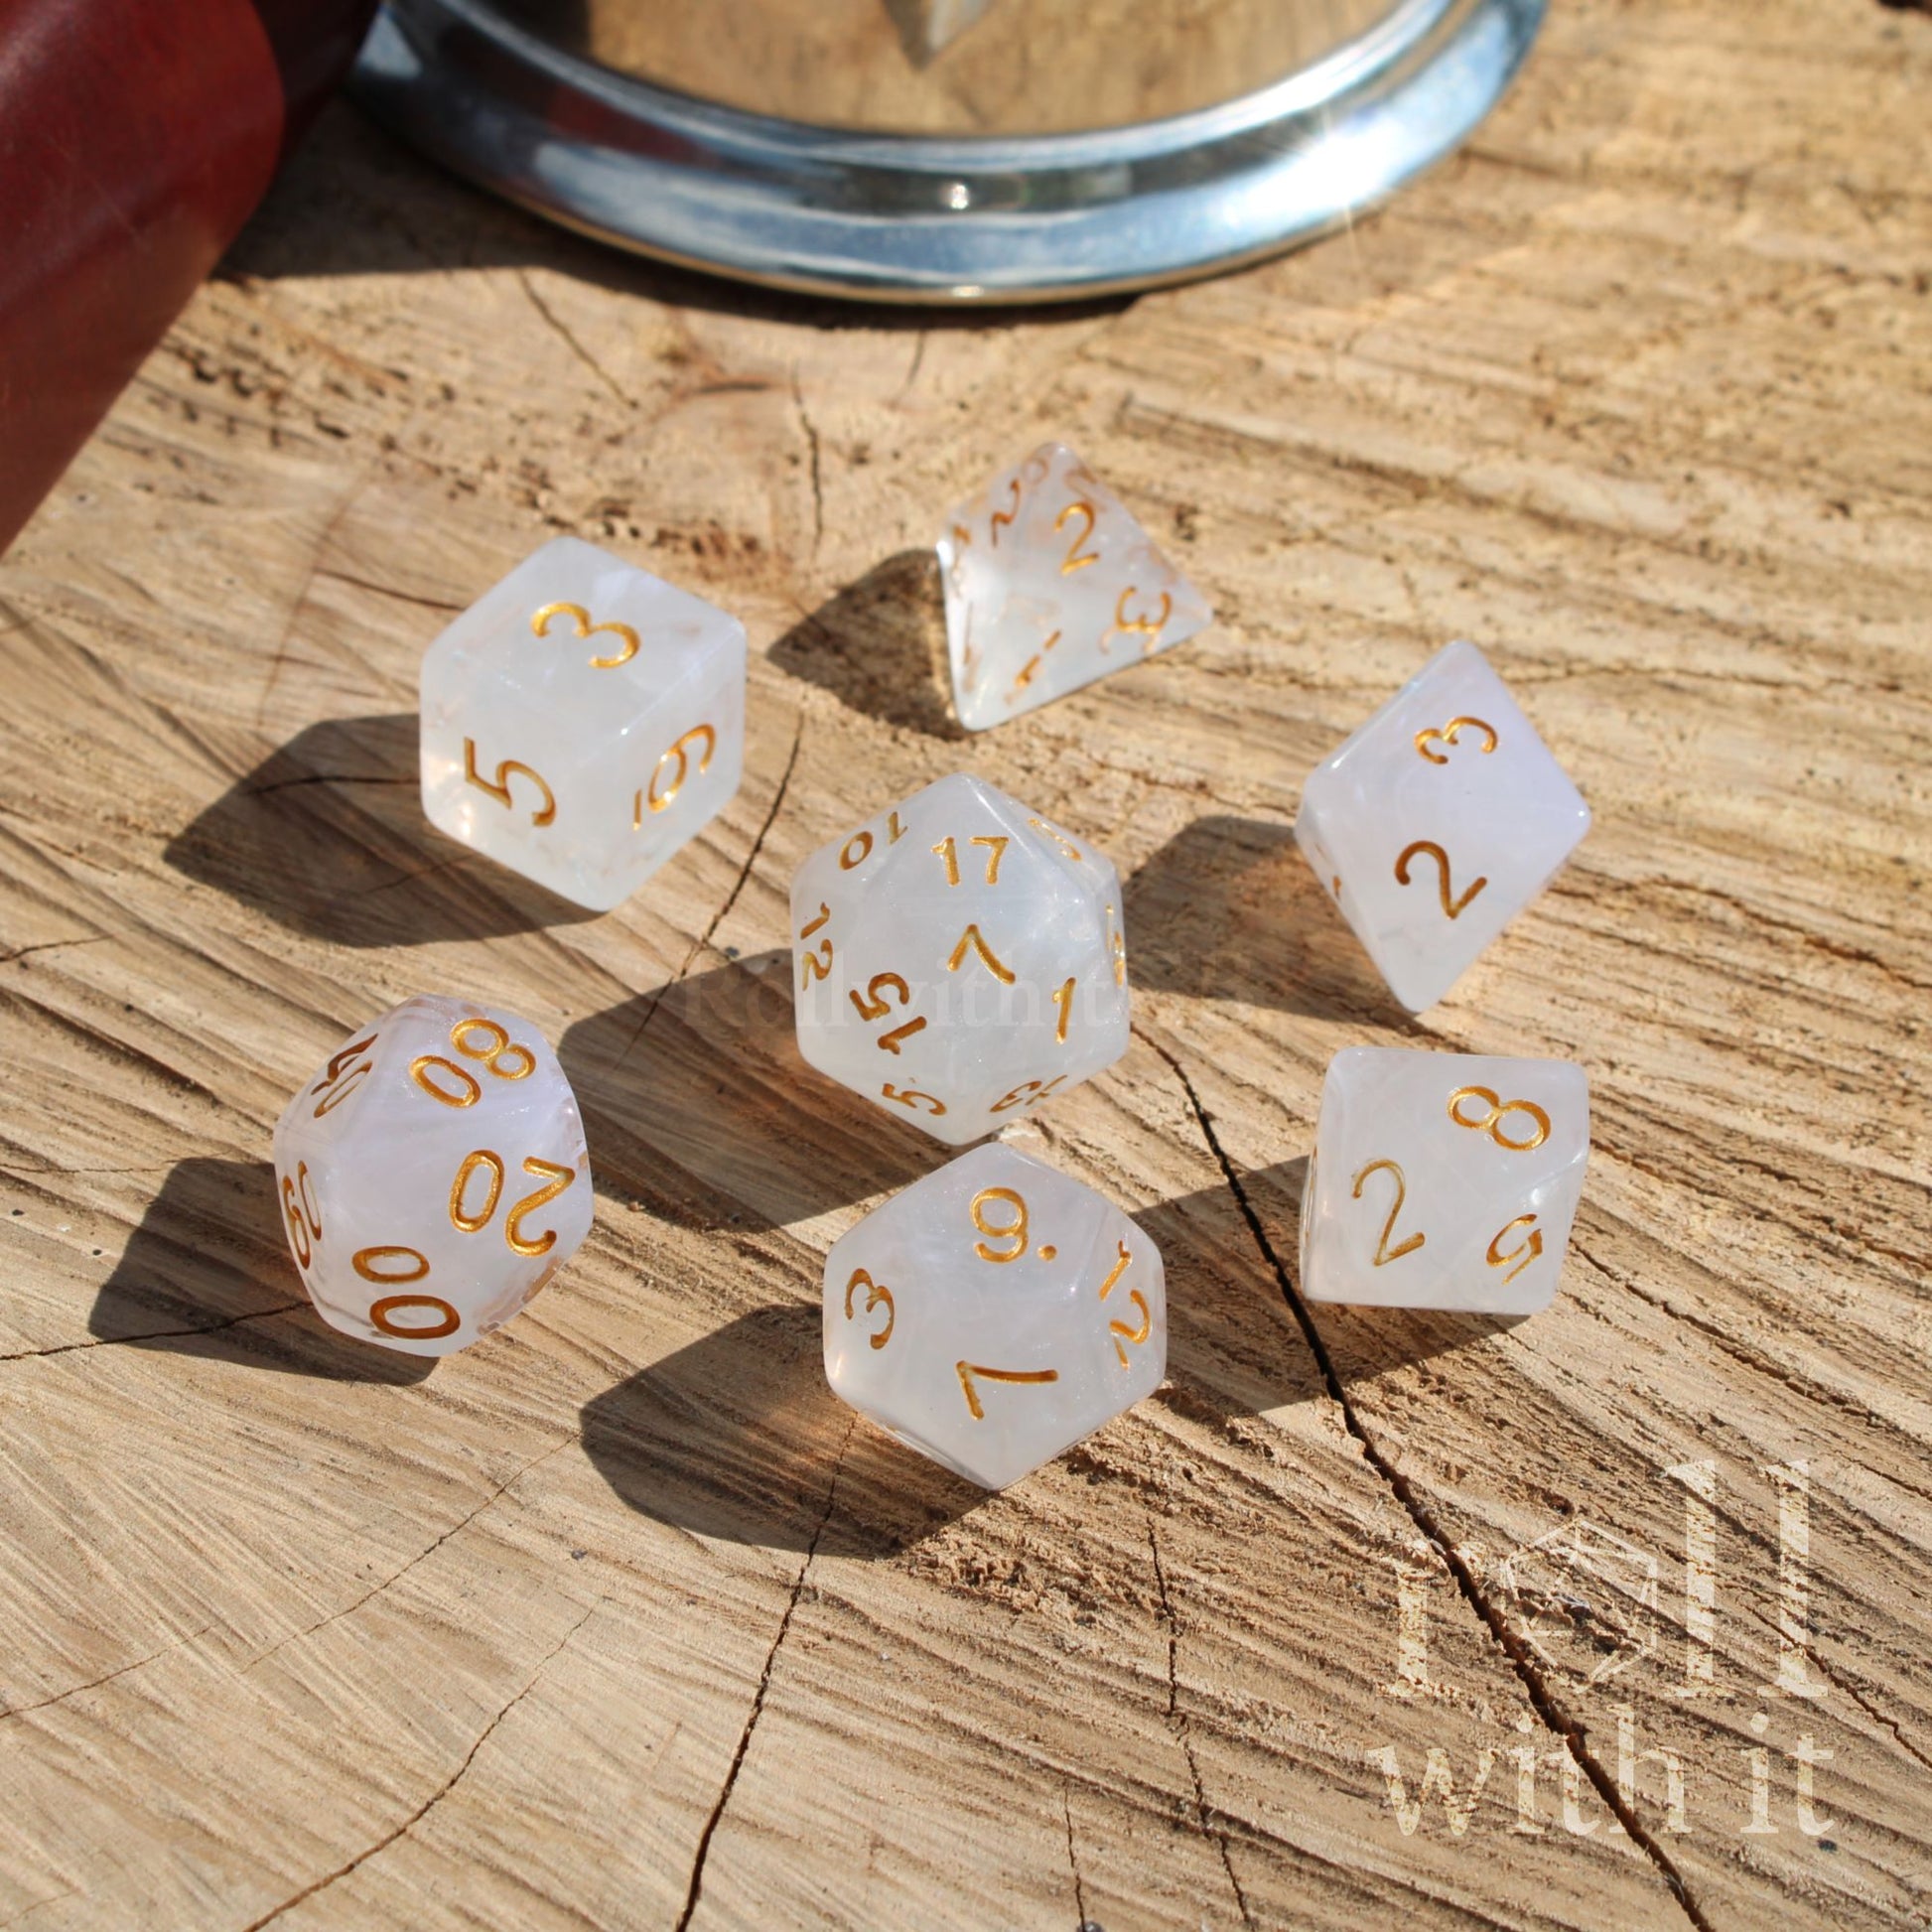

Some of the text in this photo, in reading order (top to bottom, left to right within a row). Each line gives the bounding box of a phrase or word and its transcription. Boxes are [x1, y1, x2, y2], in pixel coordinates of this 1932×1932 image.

[1053, 499, 1099, 577] 2
[530, 602, 640, 668] 3
[1414, 715, 1498, 764] 3
[464, 737, 556, 827] 5
[930, 836, 1009, 887] 17
[1395, 840, 1487, 919] 2
[946, 923, 1016, 985] 7
[849, 972, 926, 1055] 15
[1051, 977, 1076, 1044] 1
[408, 1018, 536, 1108] 80
[1447, 1085, 1551, 1151] 8
[449, 1149, 576, 1258] 20
[1351, 1159, 1425, 1267] 2
[351, 1245, 461, 1340] 00
[845, 1268, 894, 1350] 3
[956, 1360, 1058, 1420] 7
